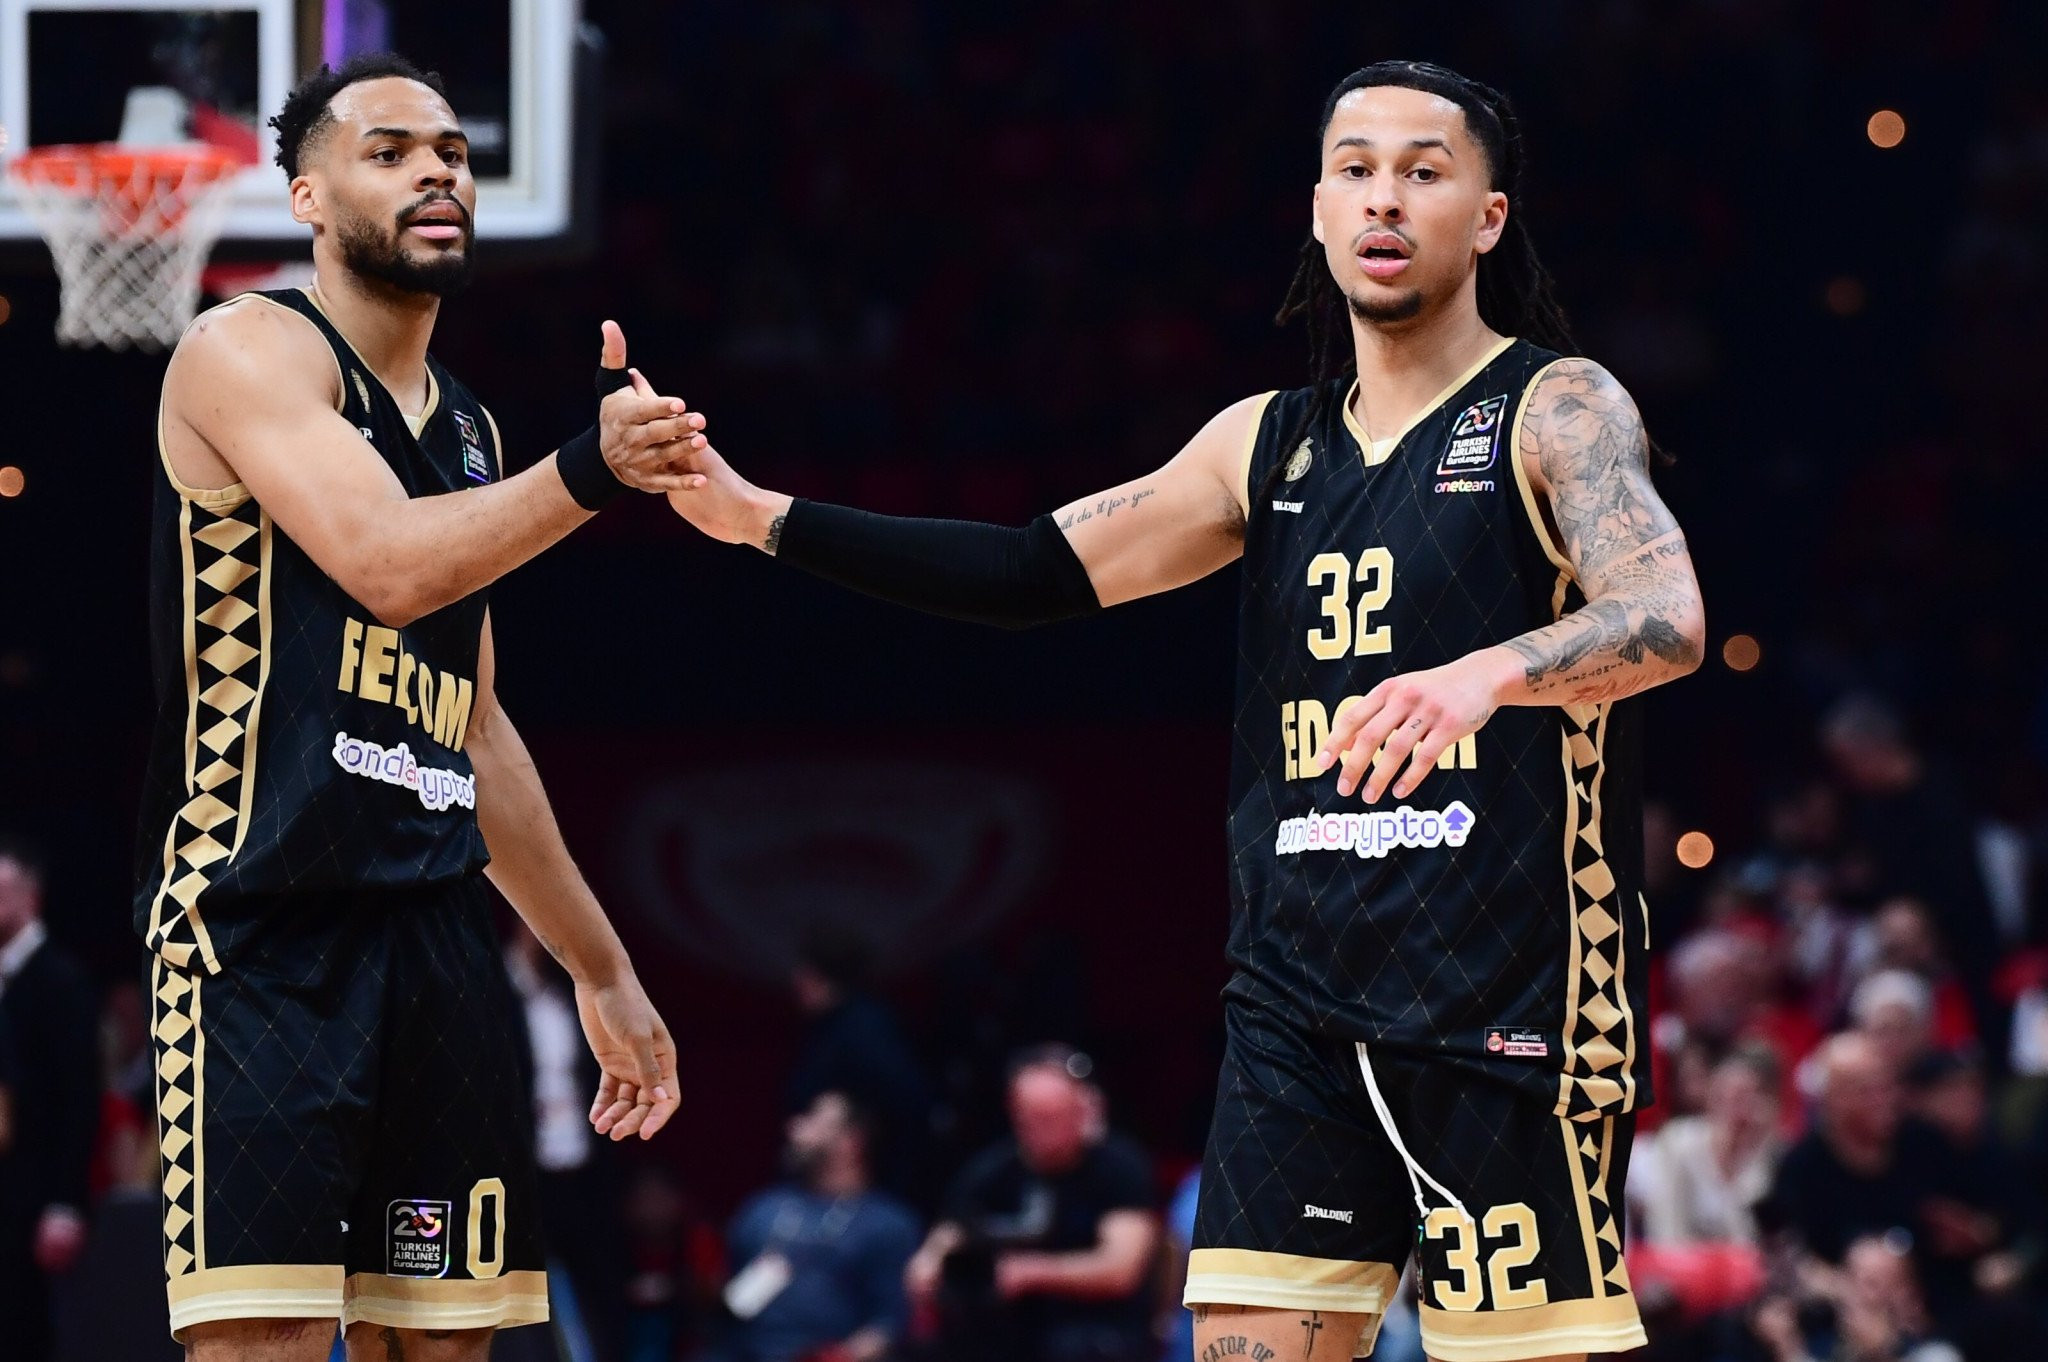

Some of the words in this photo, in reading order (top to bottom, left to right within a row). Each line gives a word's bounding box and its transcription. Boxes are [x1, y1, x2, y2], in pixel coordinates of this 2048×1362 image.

[1456, 402, 1501, 435] 25
[1448, 445, 1490, 457] AIRLINES
[1452, 436, 1492, 449] TURKISH
[1434, 479, 1495, 493] oneteam
[1060, 513, 1074, 531] ill
[1107, 496, 1127, 517] for
[1132, 488, 1156, 508] you
[1307, 547, 1394, 661] 32
[394, 1206, 442, 1238] 25
[1303, 1204, 1354, 1224] SPALDING
[467, 1177, 506, 1280] 0
[393, 1251, 441, 1262] AIRLINES
[394, 1242, 441, 1253] TURKISH
[1424, 1202, 1549, 1312] 32
[393, 1260, 441, 1271] EuroLeague
